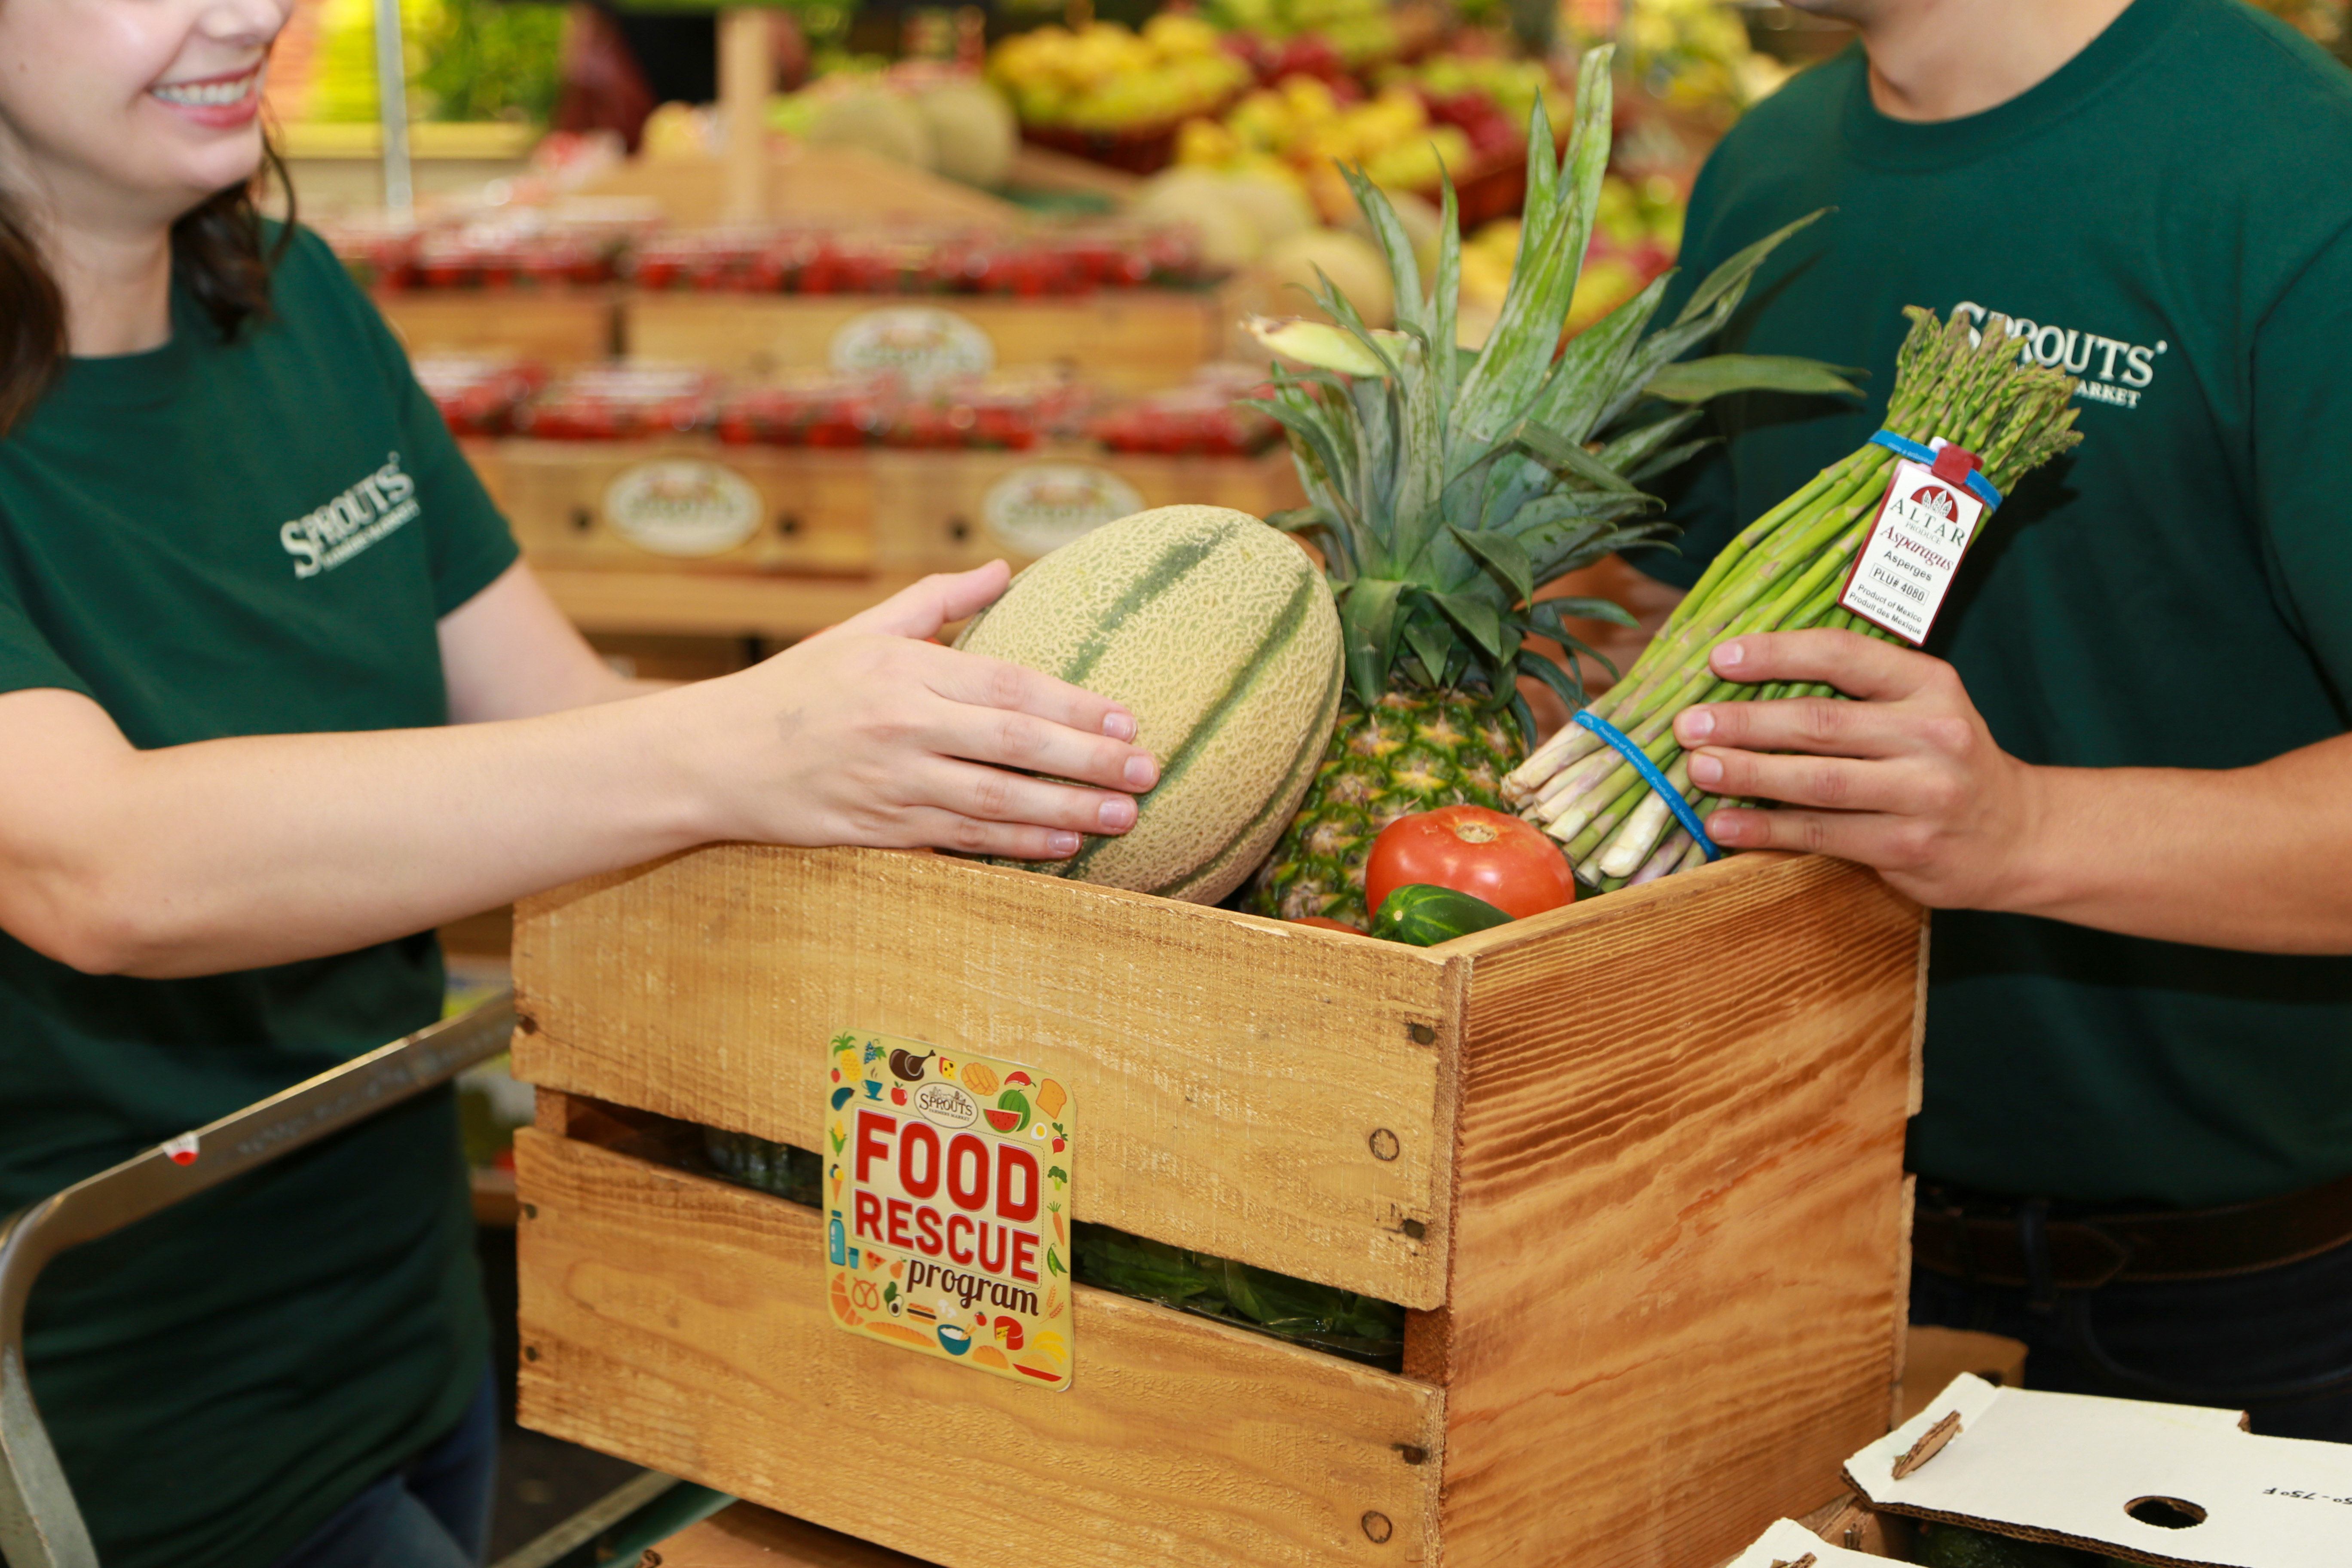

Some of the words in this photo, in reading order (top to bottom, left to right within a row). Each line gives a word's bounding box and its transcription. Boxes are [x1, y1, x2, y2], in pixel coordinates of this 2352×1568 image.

[2073, 380, 2141, 409] ARKET
[280, 463, 414, 579] SPROUTS
[1890, 497, 1966, 547] ALTAR
[1905, 521, 1942, 545] PRODUCE
[1880, 525, 1954, 571] Asparagus
[1883, 550, 1932, 581] Asperges
[1858, 584, 1887, 604] Product
[1896, 604, 1922, 622] Mexico
[1873, 567, 1900, 588] PLU#
[1900, 582, 1925, 602] 4080
[1849, 591, 1876, 611] Produit
[1877, 606, 1890, 619] des
[1891, 614, 1922, 635] Mexique
[1626, 748, 1648, 772] Mexico
[919, 1093, 972, 1116] SPROUTS
[855, 1108, 1040, 1224] FOOD
[854, 1188, 1040, 1284] RESCUE
[907, 1259, 1039, 1316] program
